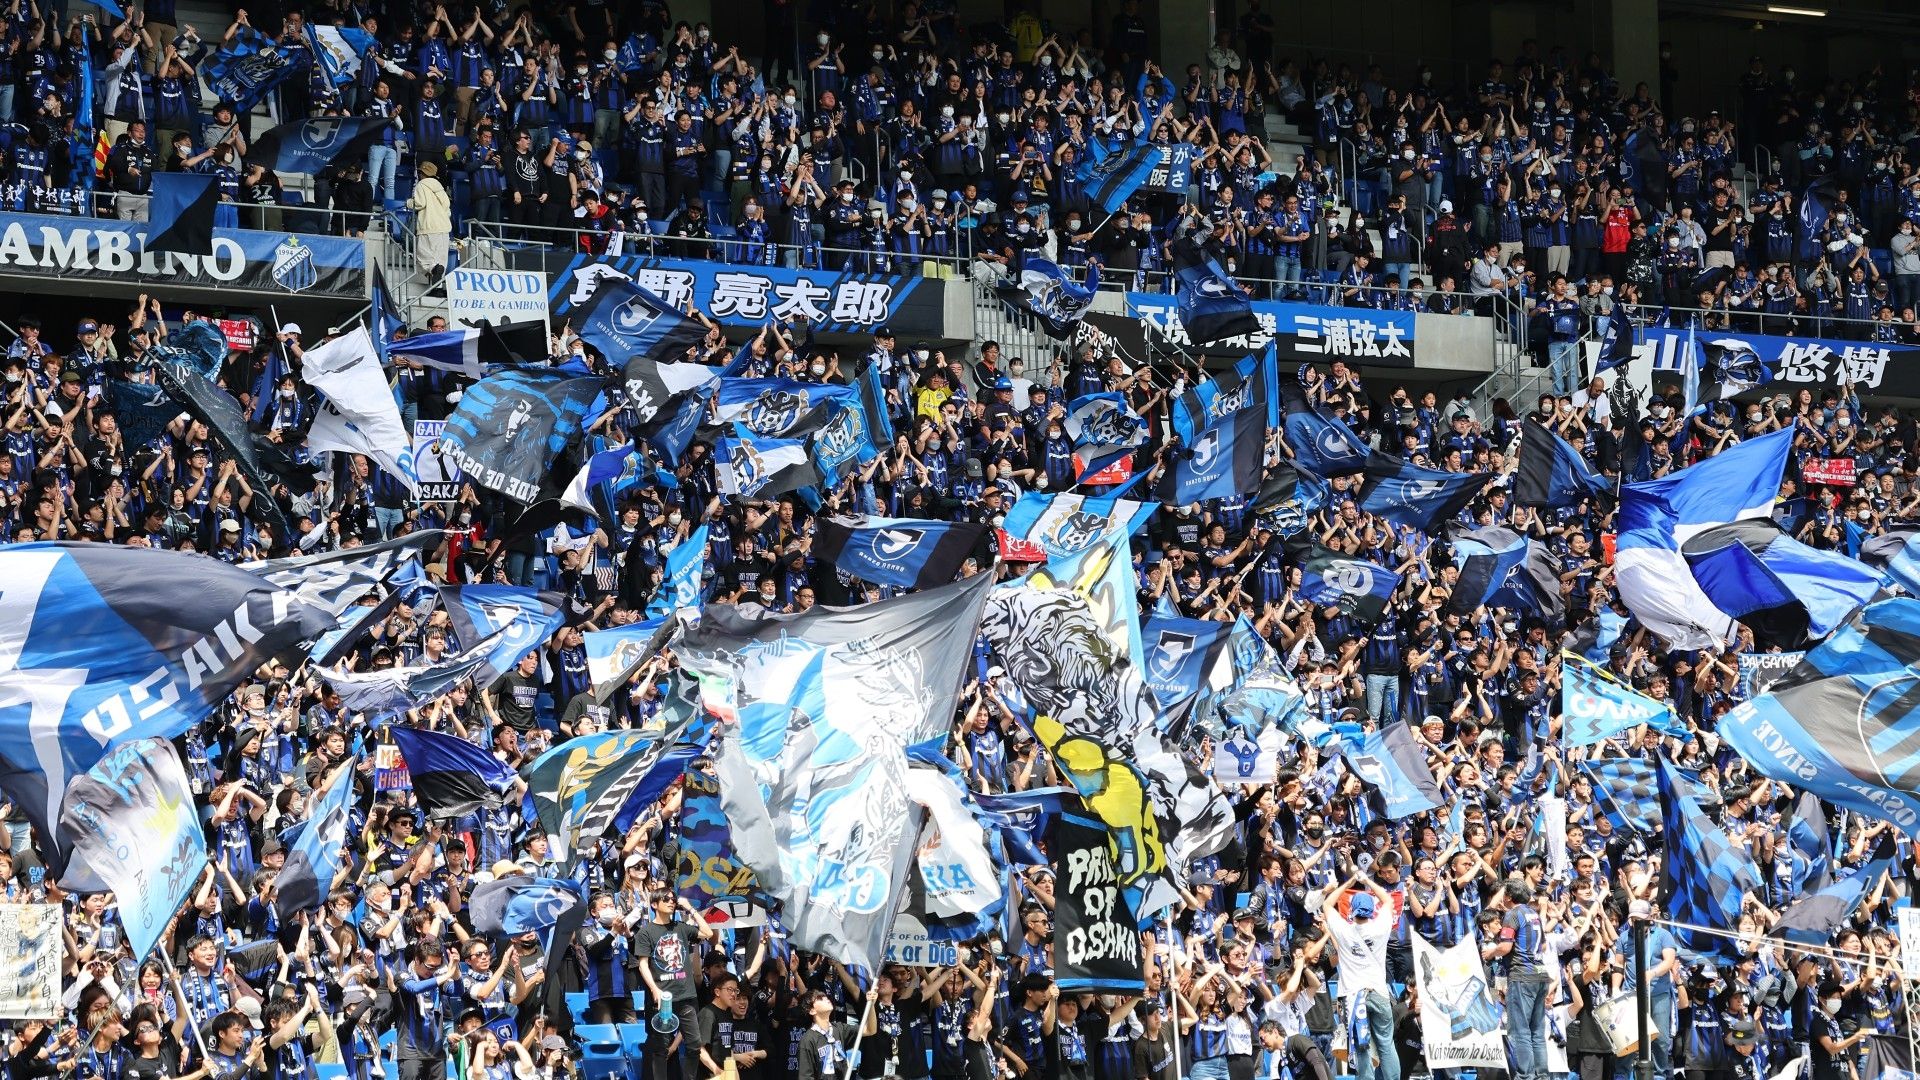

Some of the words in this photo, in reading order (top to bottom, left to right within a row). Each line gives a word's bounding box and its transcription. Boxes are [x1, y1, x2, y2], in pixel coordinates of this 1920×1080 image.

[274, 249, 310, 280] GAMBINO
[454, 270, 541, 294] PROUD
[709, 272, 892, 325] 亮太郎
[453, 300, 471, 308] TO
[471, 299, 485, 308] BE
[489, 301, 496, 309] A
[498, 301, 546, 311] GAMBINO
[1294, 315, 1411, 358] 三浦弦太
[1774, 341, 1890, 389] 悠樹
[1083, 886, 1117, 922] OF
[902, 945, 922, 962] or
[928, 942, 958, 967] Die
[1066, 921, 1137, 969] OSAKA
[1443, 1042, 1469, 1060] siamo
